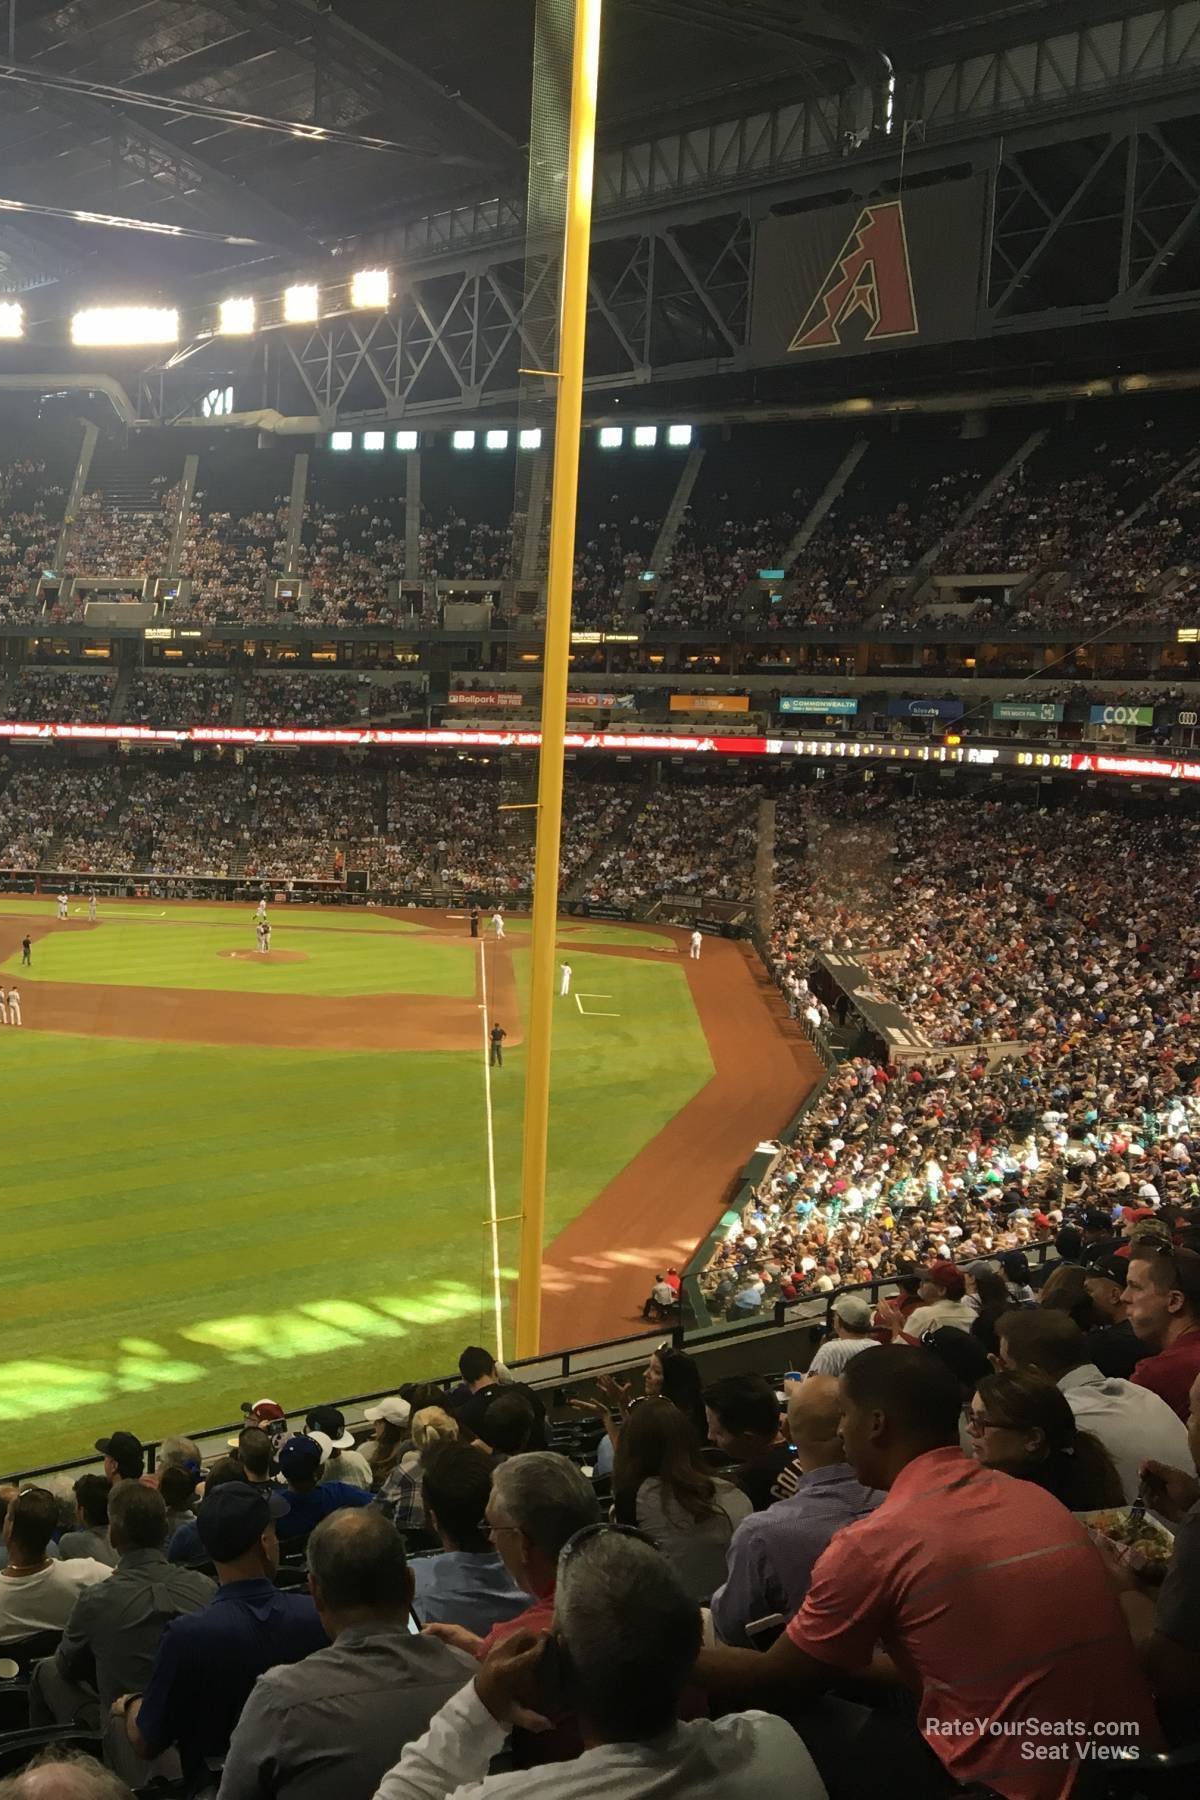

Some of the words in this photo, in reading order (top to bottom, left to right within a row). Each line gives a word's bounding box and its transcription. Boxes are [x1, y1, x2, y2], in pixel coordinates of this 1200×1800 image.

[458, 695, 495, 705] Ballpark
[793, 700, 856, 709] COMMONWEALTH
[1103, 706, 1140, 724] COX
